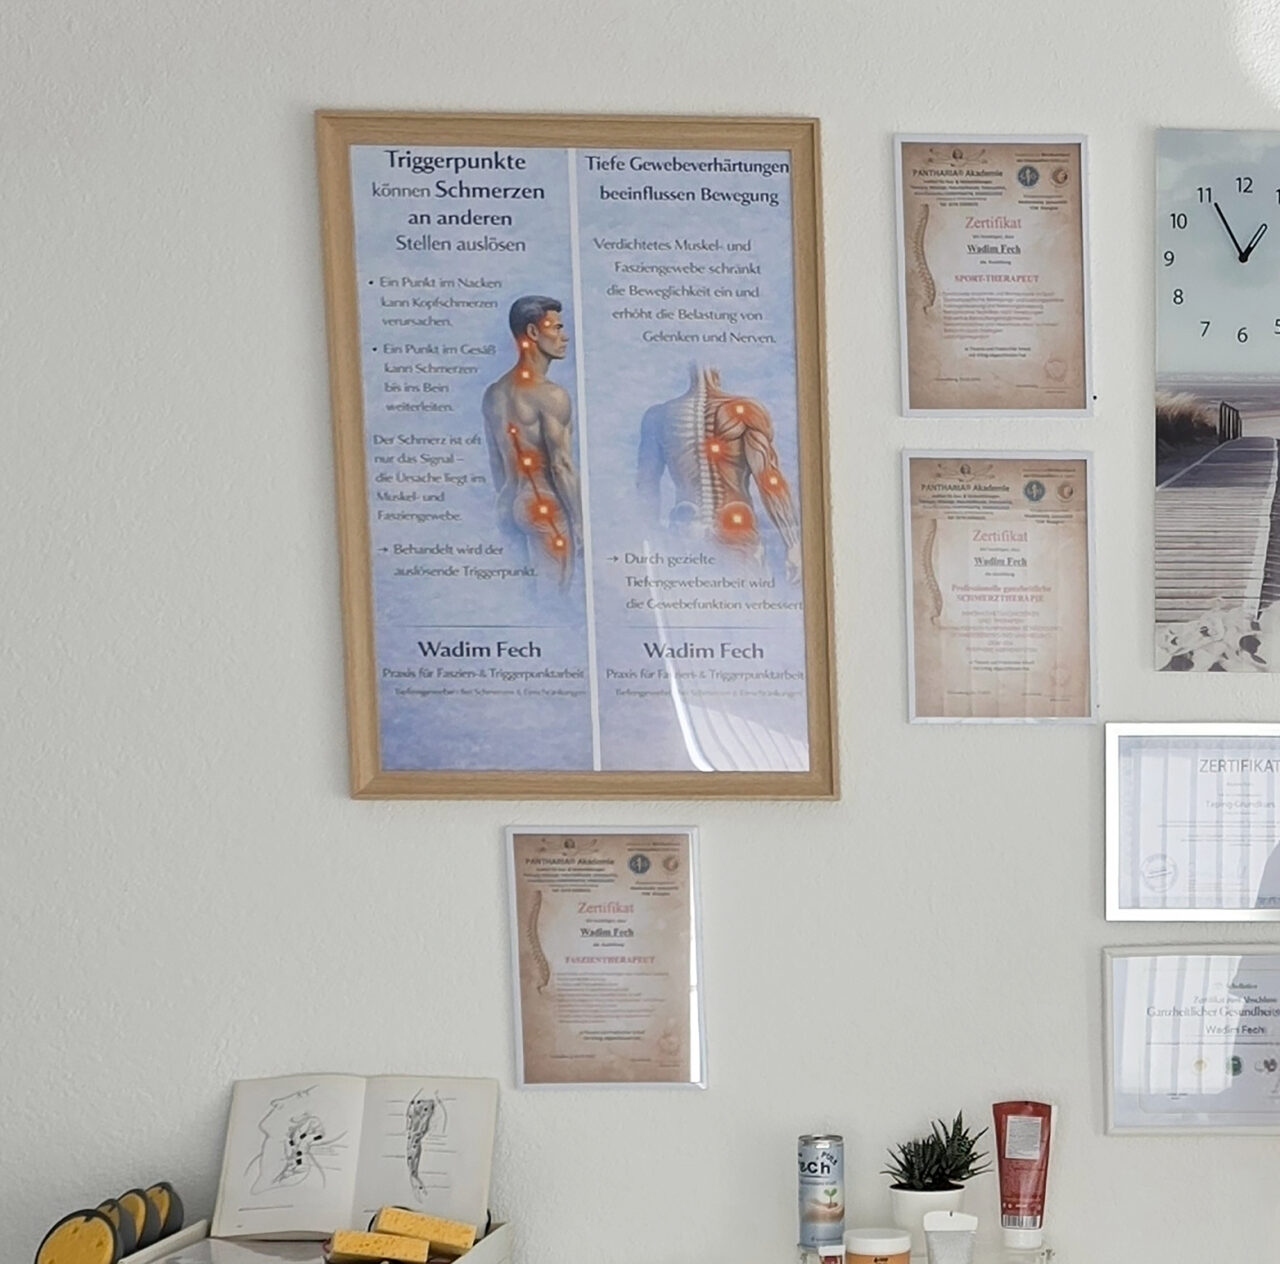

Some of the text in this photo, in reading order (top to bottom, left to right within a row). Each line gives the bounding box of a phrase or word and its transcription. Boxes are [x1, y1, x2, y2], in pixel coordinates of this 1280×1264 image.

[384, 150, 527, 174] Triggerpunkte
[585, 156, 790, 177] Tiefe Gewebeverhärtungen
[372, 180, 545, 199] können Schmerzen
[1236, 177, 1253, 193] 12
[600, 185, 779, 207] beeinflussen Bewegung
[1197, 187, 1212, 203] 11
[408, 209, 512, 226] an anderen
[965, 216, 1023, 229] Zertifikat
[1170, 213, 1187, 229] 10
[396, 235, 526, 252] Stellen auslösen
[593, 238, 752, 252] Verdichtetes Muskel- und
[967, 245, 1021, 255] Wadim Fech
[1164, 251, 1175, 267] 9
[615, 261, 762, 276] Fasziengewebe schränkt
[380, 276, 502, 288] Ein Punkt im Nacken
[607, 284, 759, 300] die Beweglichkeit ein und
[1173, 289, 1184, 305] 8
[381, 297, 498, 310] kann Kopfschmerzen
[612, 308, 763, 323] erhöht die Belastung von
[1200, 321, 1211, 337] 7
[1237, 327, 1248, 343] 6
[642, 330, 776, 343] Gelenken und Nerven.
[383, 343, 402, 354] Ein
[405, 344, 439, 355] Punkt
[442, 344, 457, 354] im
[384, 363, 478, 374] kann Schmerzen
[384, 382, 401, 393] bis
[423, 382, 449, 393] Bein
[374, 434, 482, 446] Der Schmerz ist oft
[374, 453, 454, 467] nur das Signal
[375, 473, 393, 484] die
[396, 472, 442, 484] Ursache
[422, 491, 446, 502] und
[972, 530, 1028, 542] Zertifikat
[393, 544, 504, 555] Behandelt wird der
[625, 553, 716, 567] Durch gezielte
[974, 556, 1027, 567] Wadim Fech
[393, 565, 460, 577] auslösende
[625, 576, 775, 590] Tiefengewebearbeit wird
[626, 599, 644, 609] die
[647, 599, 742, 610] Gewebefunktion
[417, 640, 542, 658] Wadim Fech
[643, 642, 764, 659] Wadim Fech
[382, 668, 416, 679] Praxis
[419, 667, 433, 679] für
[489, 667, 585, 681] Triggerpunktarbeit
[606, 669, 637, 680] Praxis
[640, 669, 654, 679] für
[708, 669, 804, 682] Triggerpunktarbeit
[578, 902, 634, 914] Zertifikat
[580, 928, 634, 938] Wadim Fech
